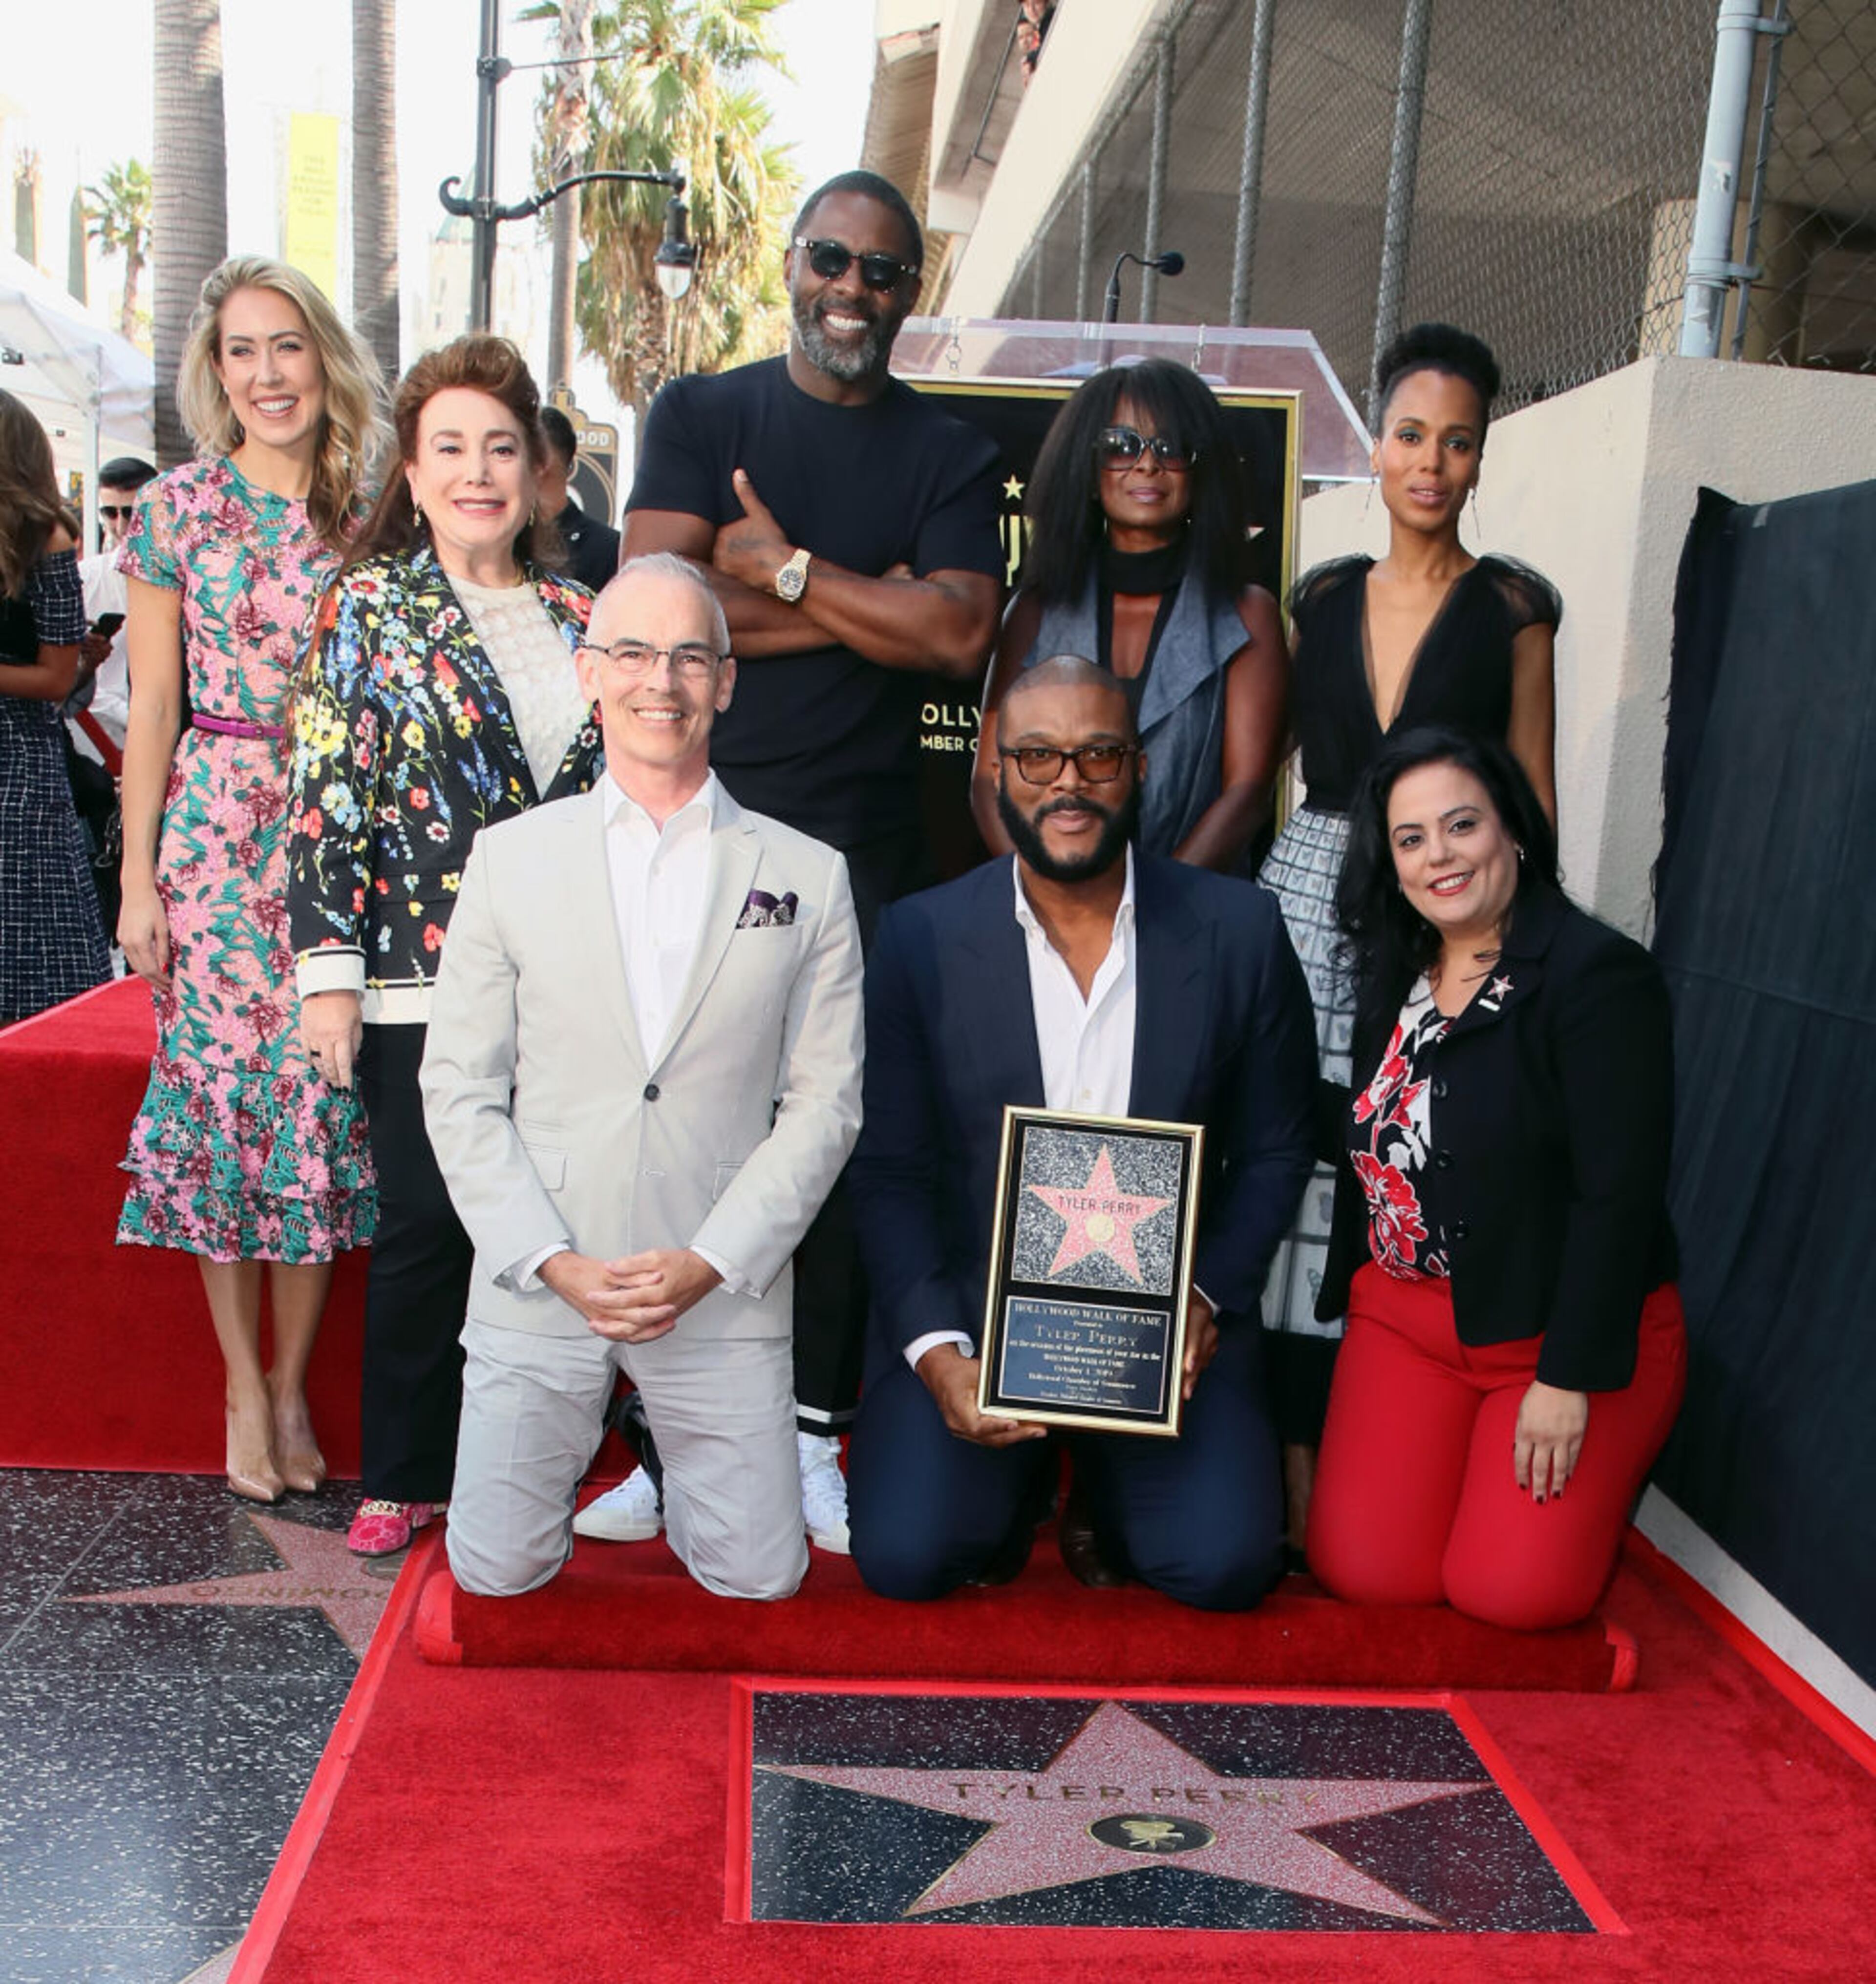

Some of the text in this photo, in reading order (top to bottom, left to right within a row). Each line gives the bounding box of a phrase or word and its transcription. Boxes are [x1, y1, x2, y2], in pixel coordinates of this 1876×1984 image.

[920, 734, 964, 751] MBER
[1058, 1196, 1141, 1215] TYLER PERRY
[1014, 1303, 1161, 1327] HOLLYWOOD WALK OF FAME
[949, 1783, 1319, 1804] TYLER PERRY
